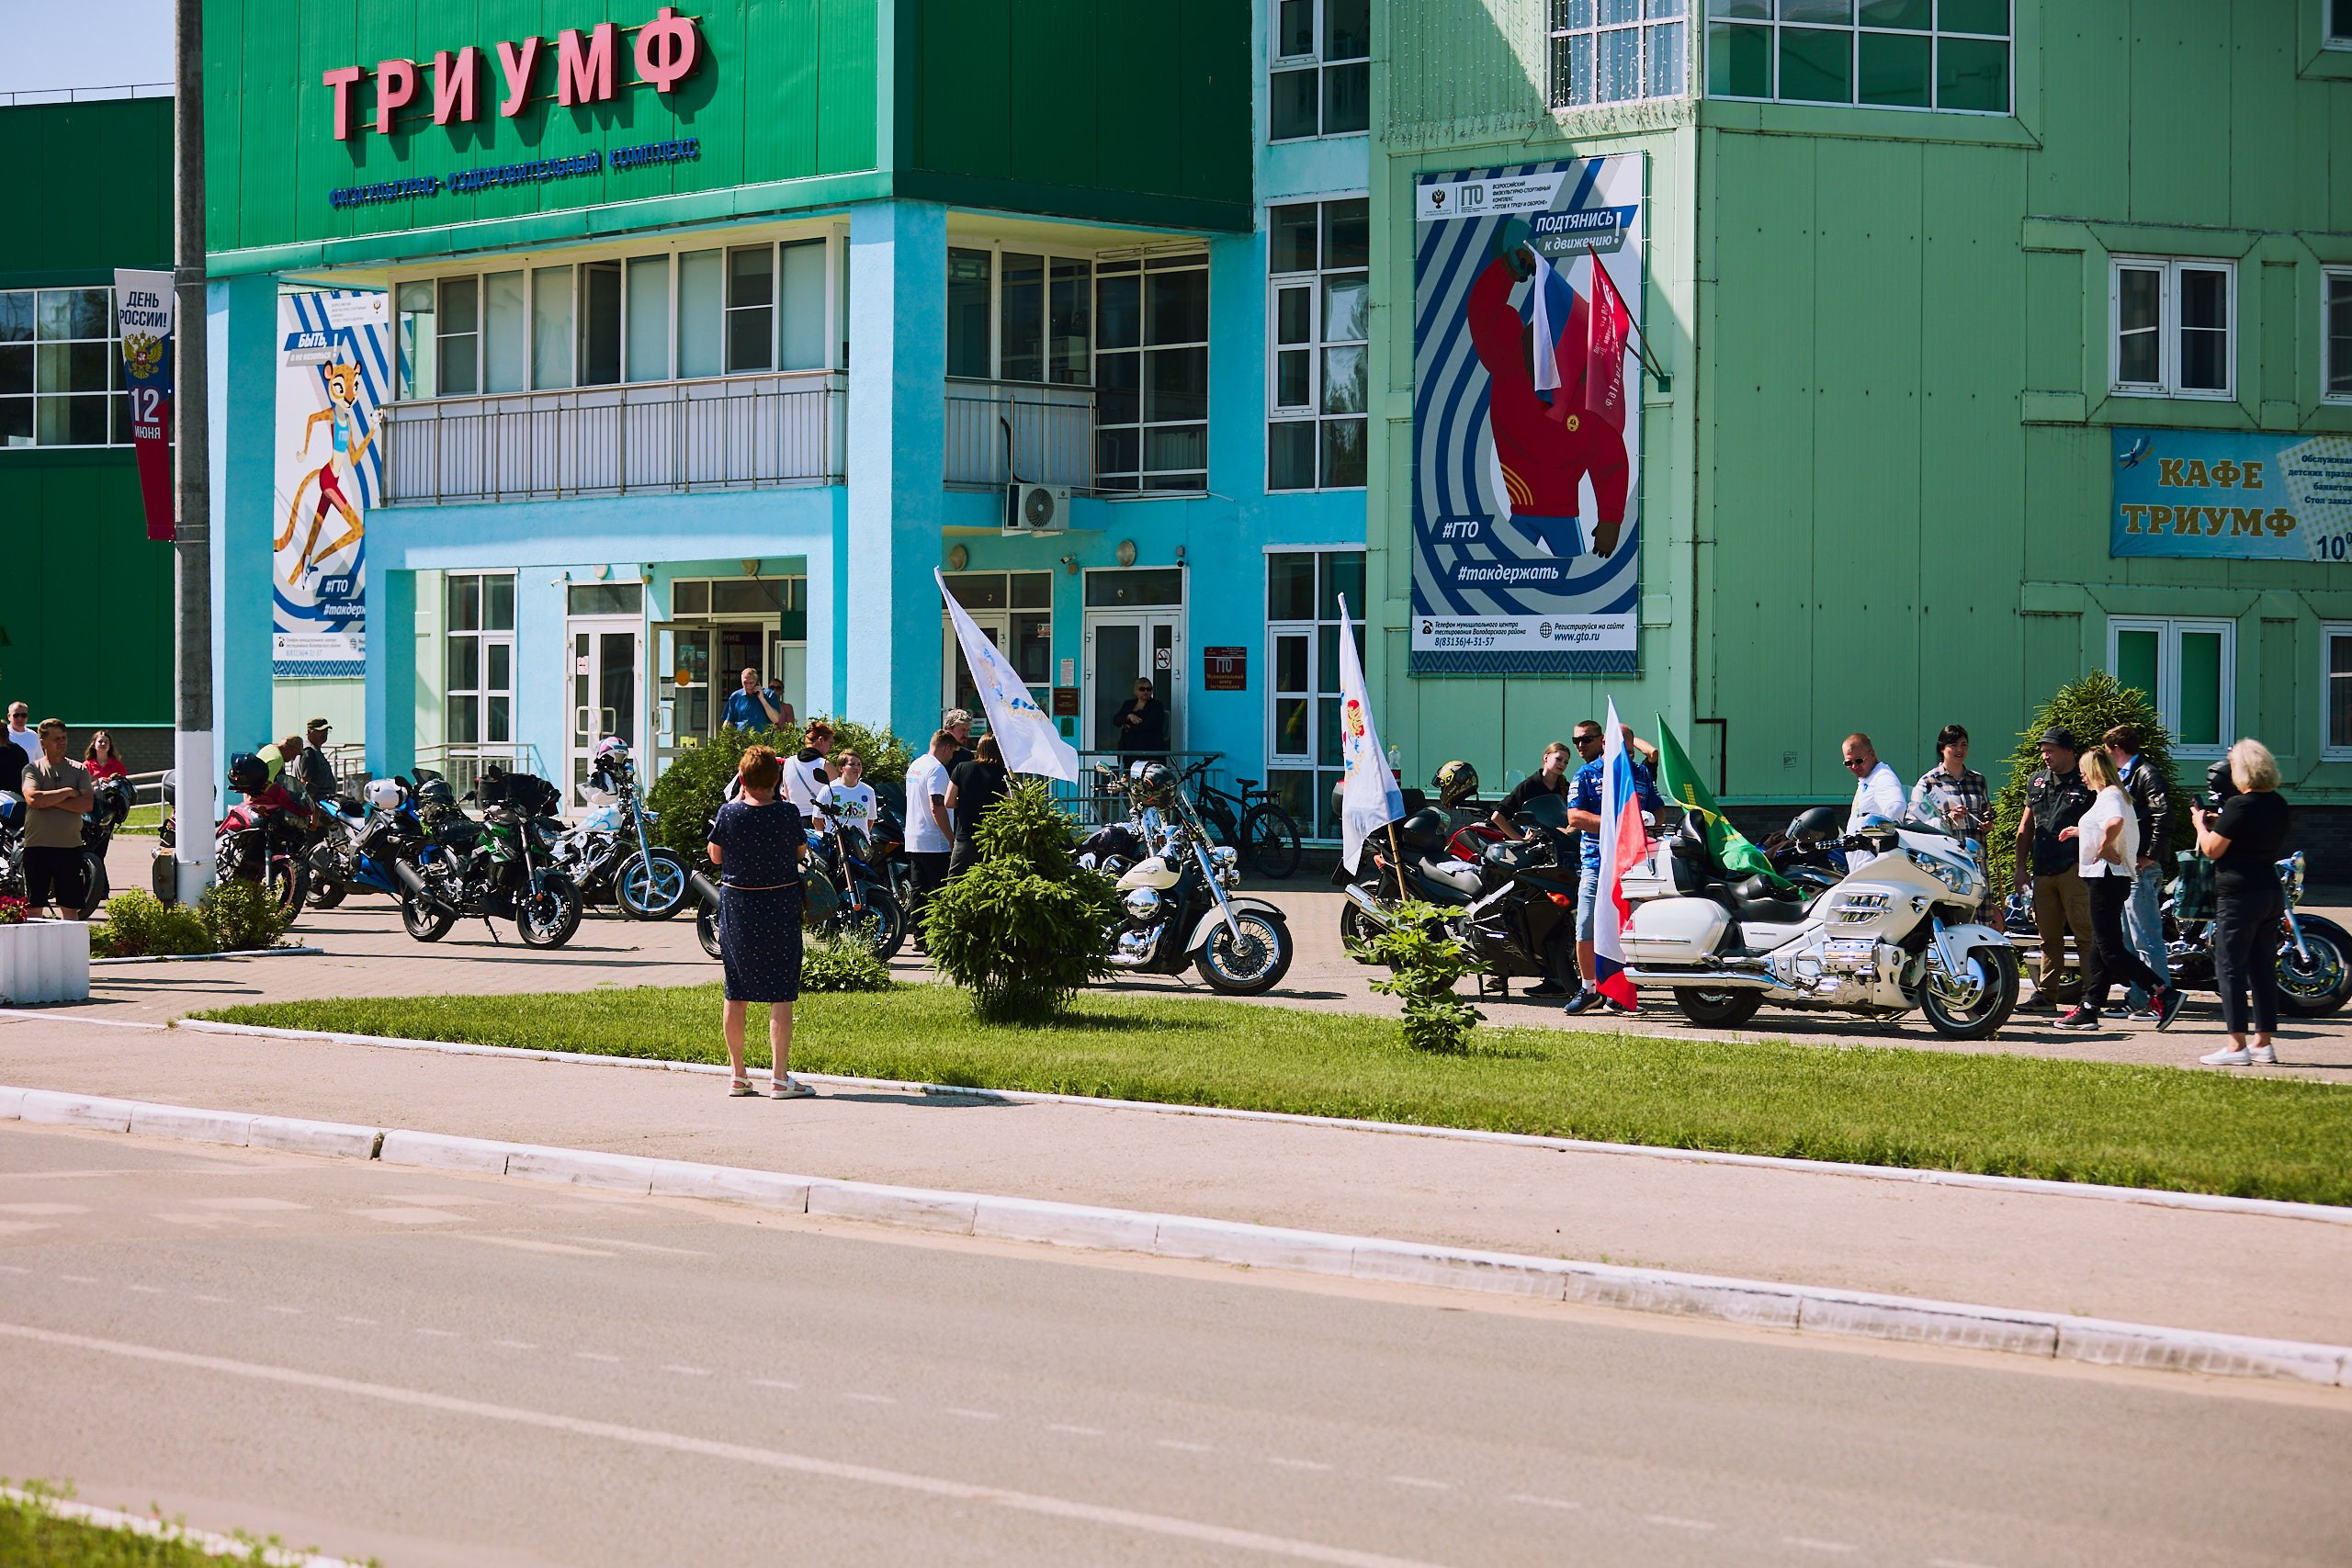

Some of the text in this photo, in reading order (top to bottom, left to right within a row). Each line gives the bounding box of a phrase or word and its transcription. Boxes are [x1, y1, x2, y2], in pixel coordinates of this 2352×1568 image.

[323, 6, 702, 141] ТРИУМФ
[607, 137, 699, 167] КОМПЛЕКС
[1544, 242, 1552, 252] к
[126, 290, 160, 309] ДЕНЬ
[119, 310, 167, 328] РОССИИ!
[298, 332, 327, 349] БЫТЬ,
[130, 388, 159, 423] 12
[134, 425, 161, 439] ИЮНЯ
[2158, 457, 2264, 490] КАФЕ
[2304, 496, 2325, 504] Стол
[2120, 503, 2297, 538] ТРИУМФ
[1442, 522, 1478, 538] #ГТО
[1458, 564, 1559, 584] #такдержать
[325, 580, 348, 593] #ГТО
[1508, 627, 1526, 636] района
[1555, 623, 1597, 631] Регистрируйся
[1606, 622, 1624, 630] сайте
[1434, 637, 1495, 648] 8(83136)4-31-57
[1555, 632, 1600, 643] www.gto.ru
